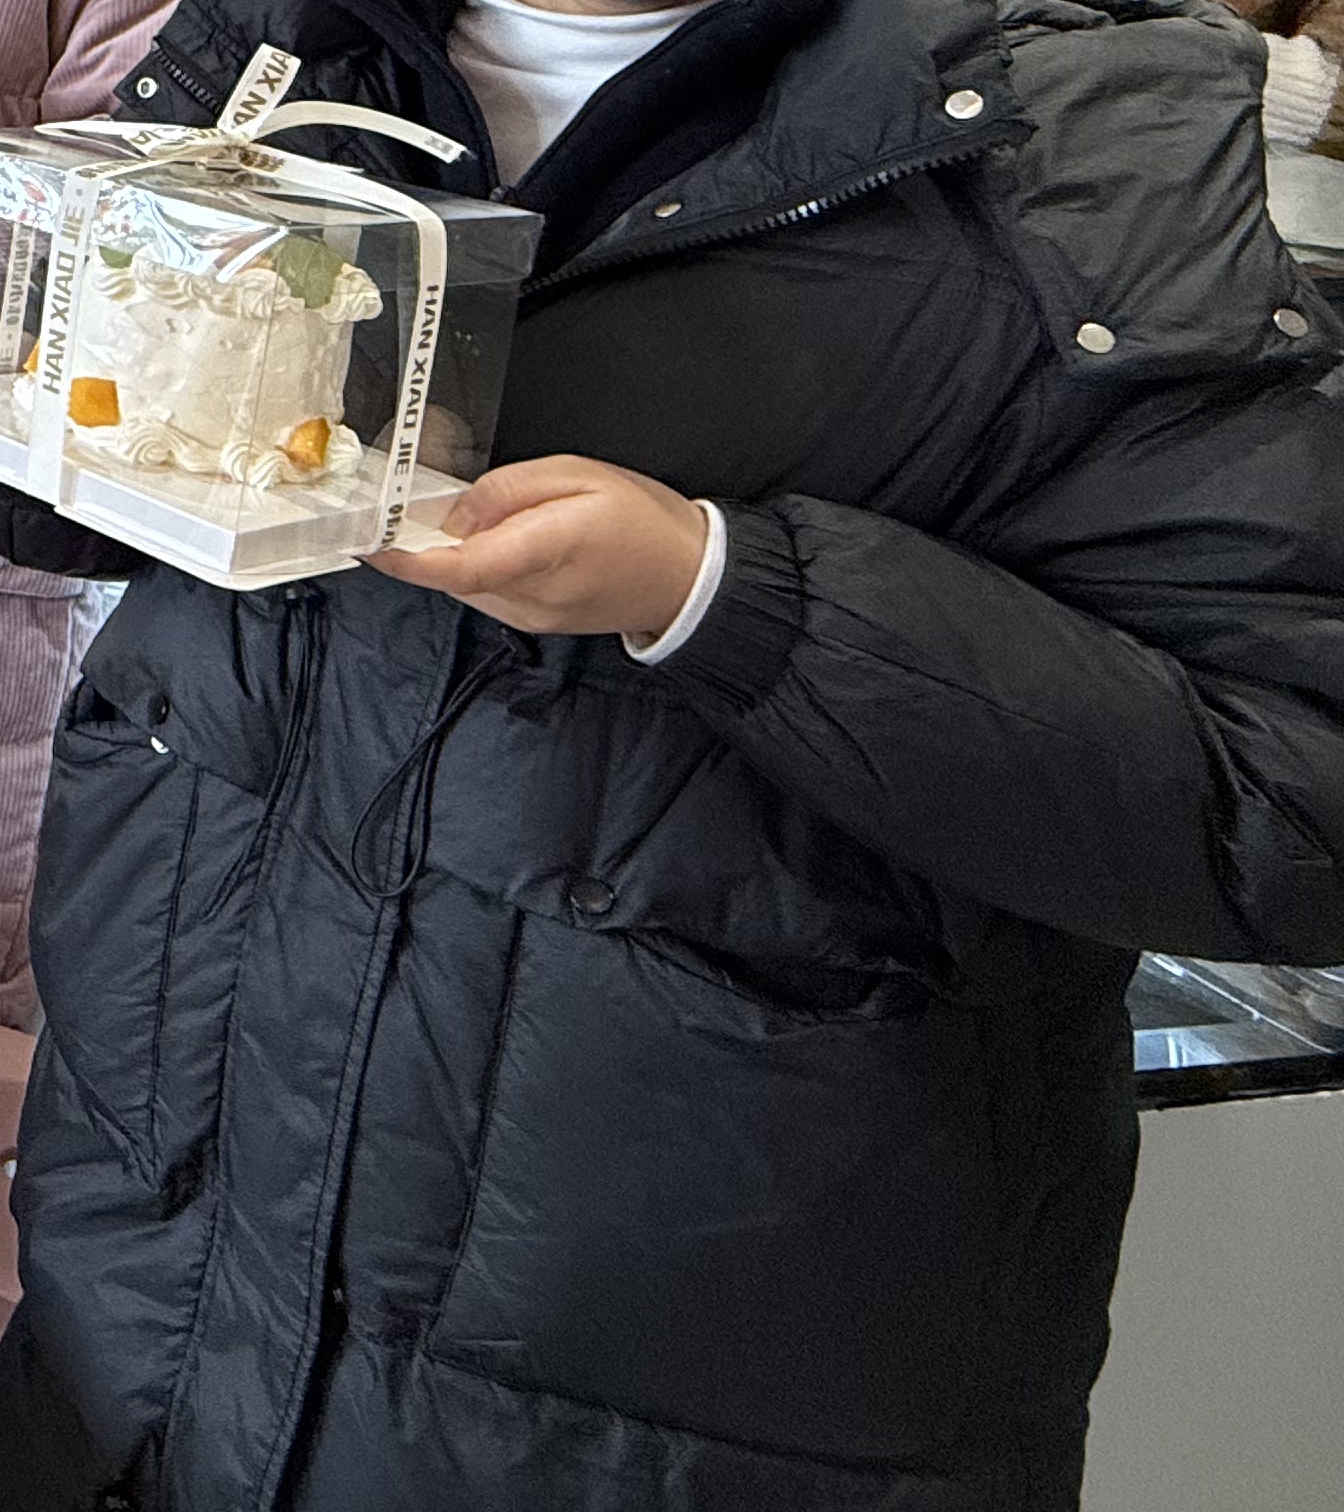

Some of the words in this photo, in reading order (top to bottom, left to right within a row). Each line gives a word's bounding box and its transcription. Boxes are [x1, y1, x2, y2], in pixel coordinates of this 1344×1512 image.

[231, 89, 268, 129] AN
[61, 205, 85, 247] JIE
[50, 250, 76, 325] XIAO
[416, 284, 440, 350] HAN
[42, 328, 67, 394] HAN
[403, 356, 429, 430] XIAO
[394, 434, 414, 476] JIE
